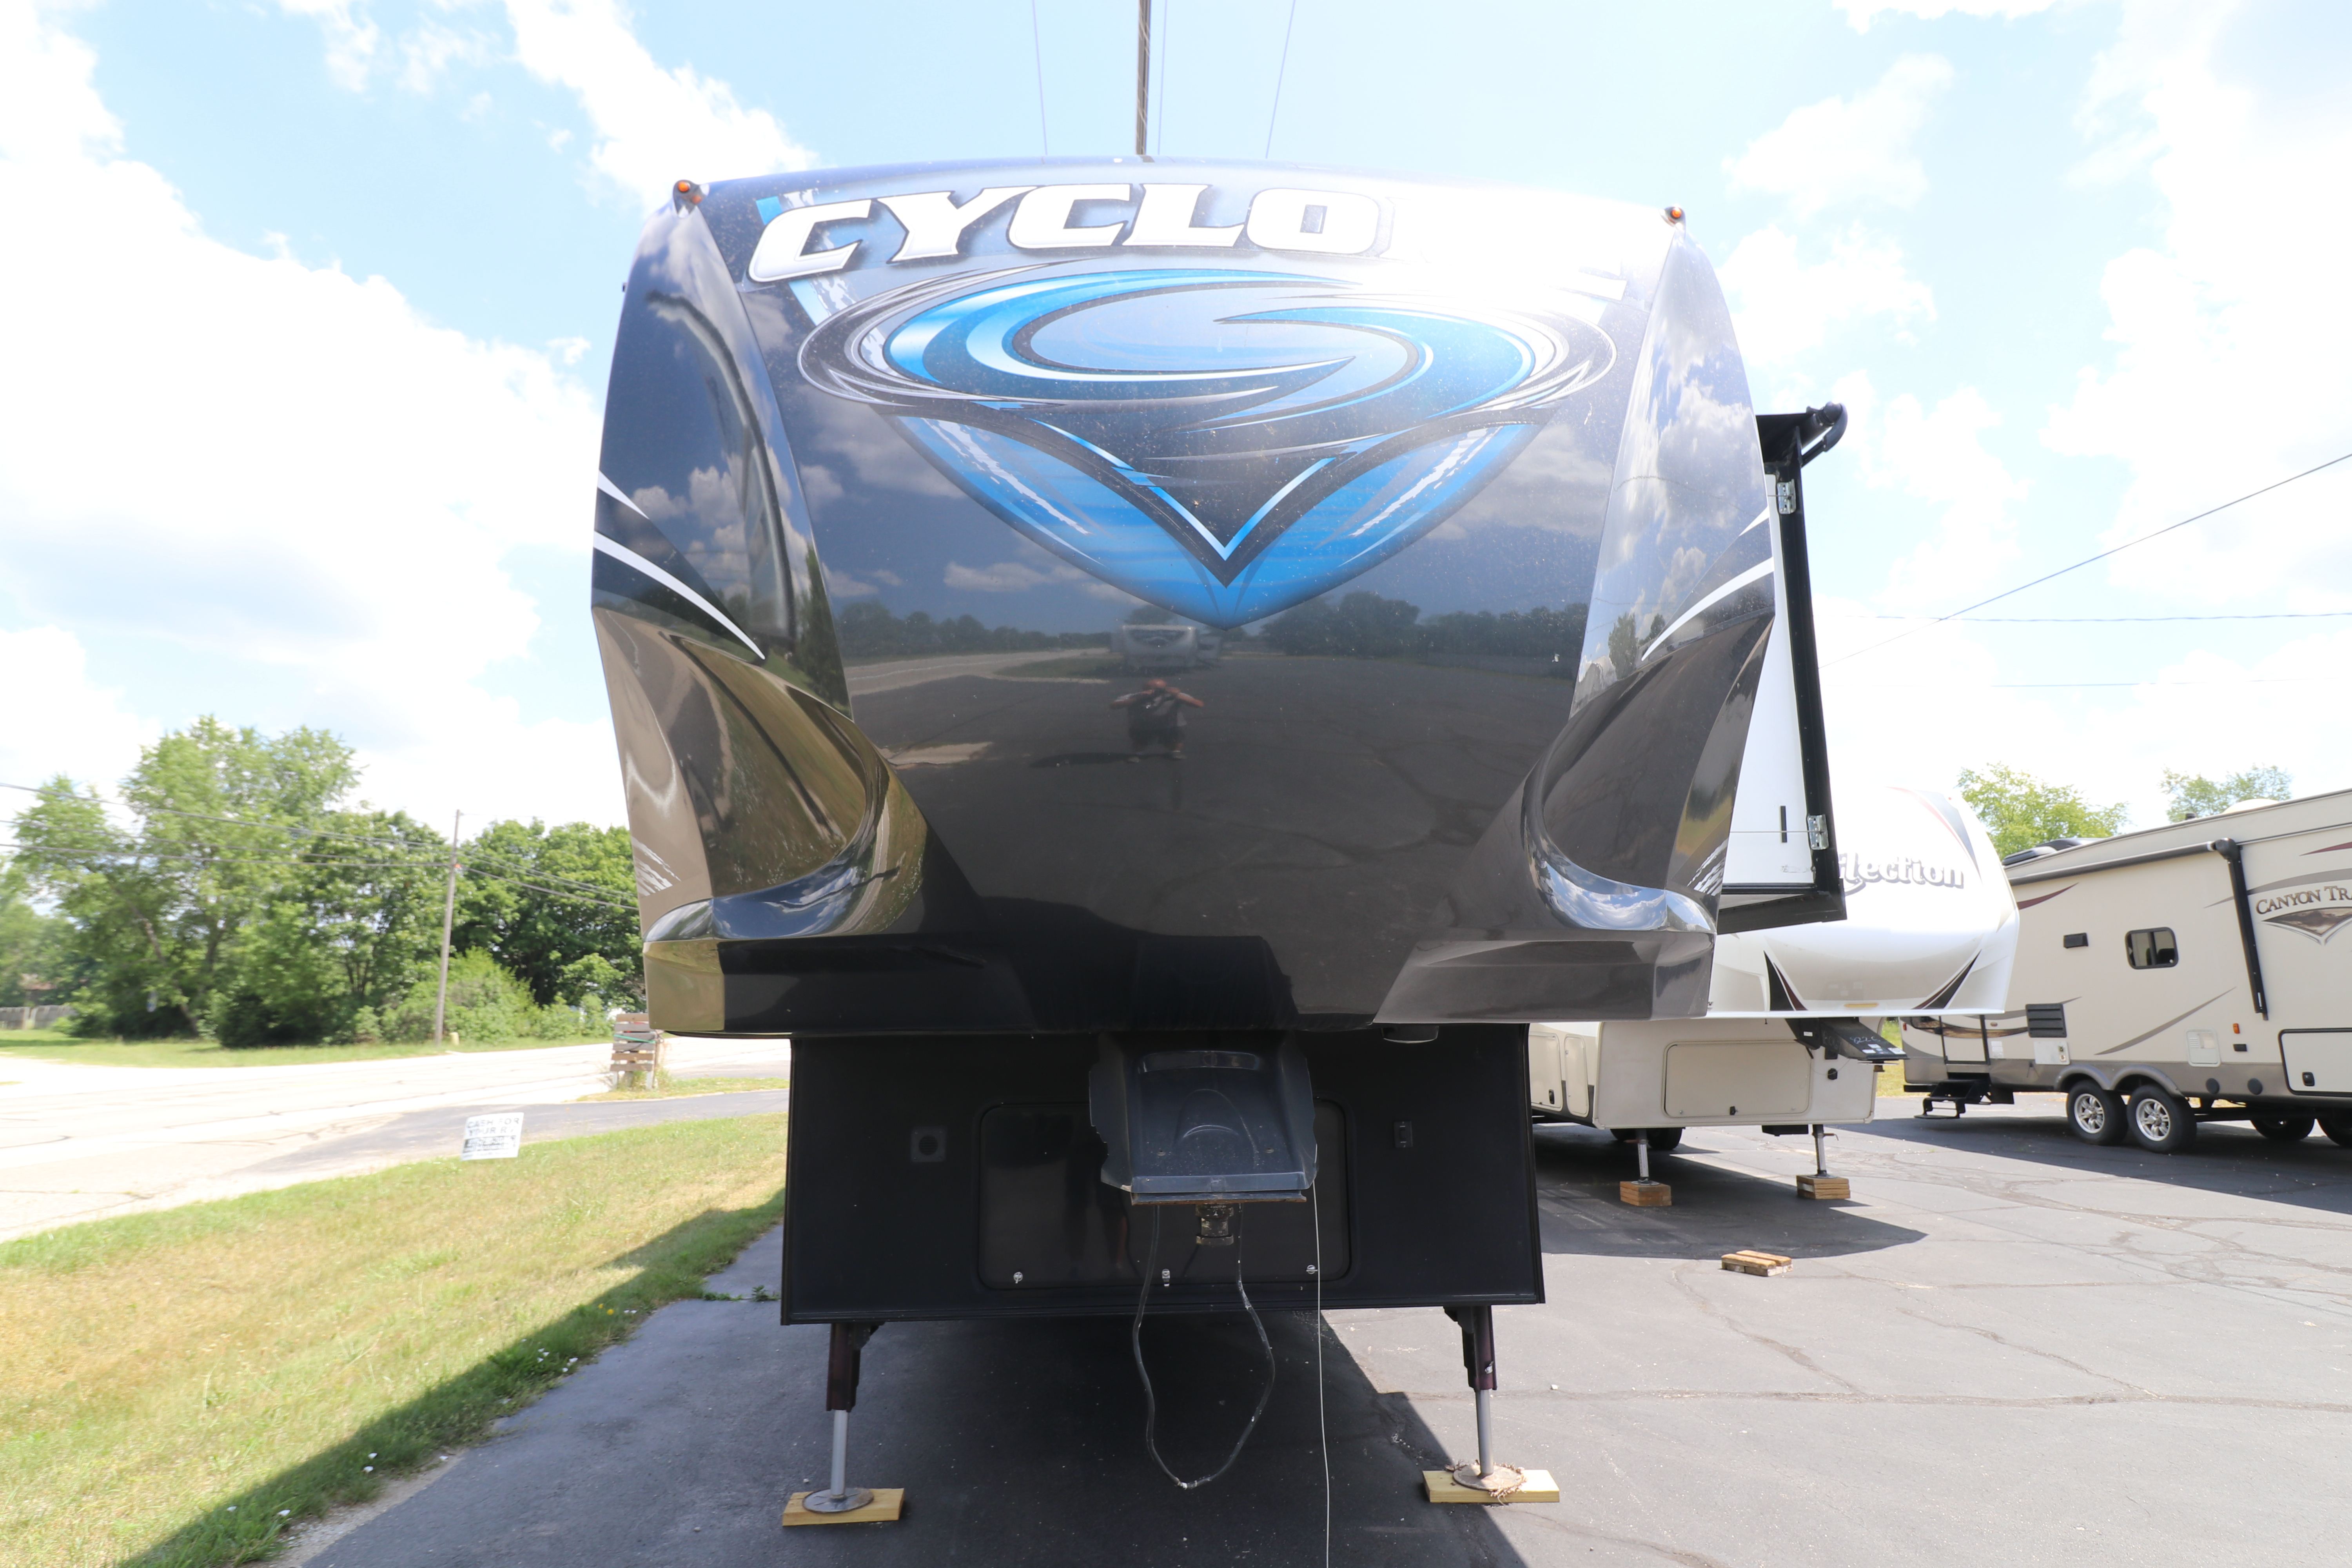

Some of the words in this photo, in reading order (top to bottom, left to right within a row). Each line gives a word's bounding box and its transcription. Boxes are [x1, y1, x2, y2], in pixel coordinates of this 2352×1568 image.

[748, 183, 1628, 301] CYCLO
[2256, 889, 2320, 915] CANYON
[2324, 885, 2352, 901] TR
[467, 1119, 494, 1129] CASH
